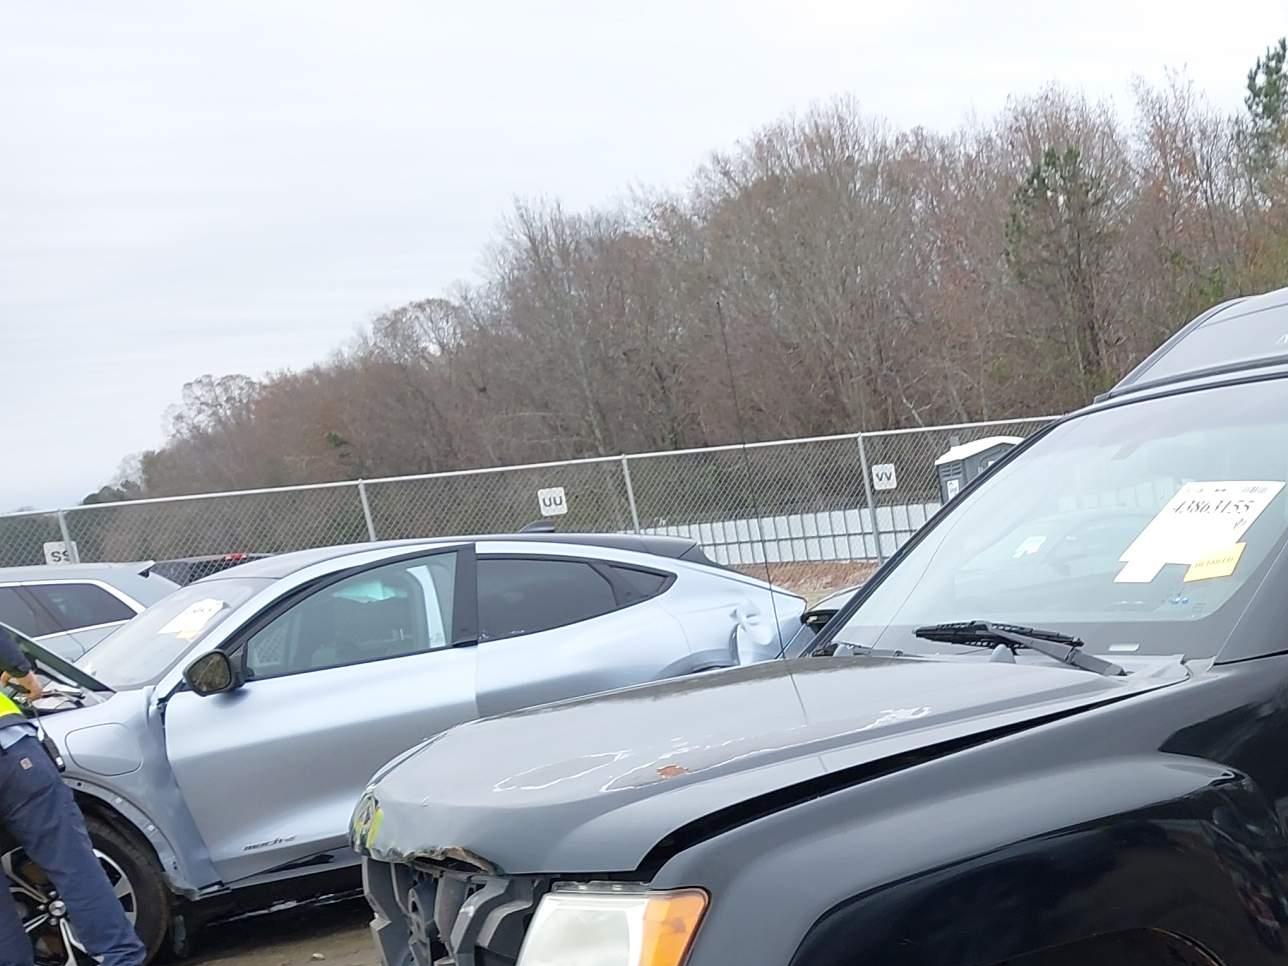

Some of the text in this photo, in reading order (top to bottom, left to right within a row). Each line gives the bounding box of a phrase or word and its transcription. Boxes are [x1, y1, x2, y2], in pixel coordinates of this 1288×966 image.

[875, 471, 893, 482] VV
[542, 495, 564, 508] UU
[1172, 499, 1256, 515] 43863155
